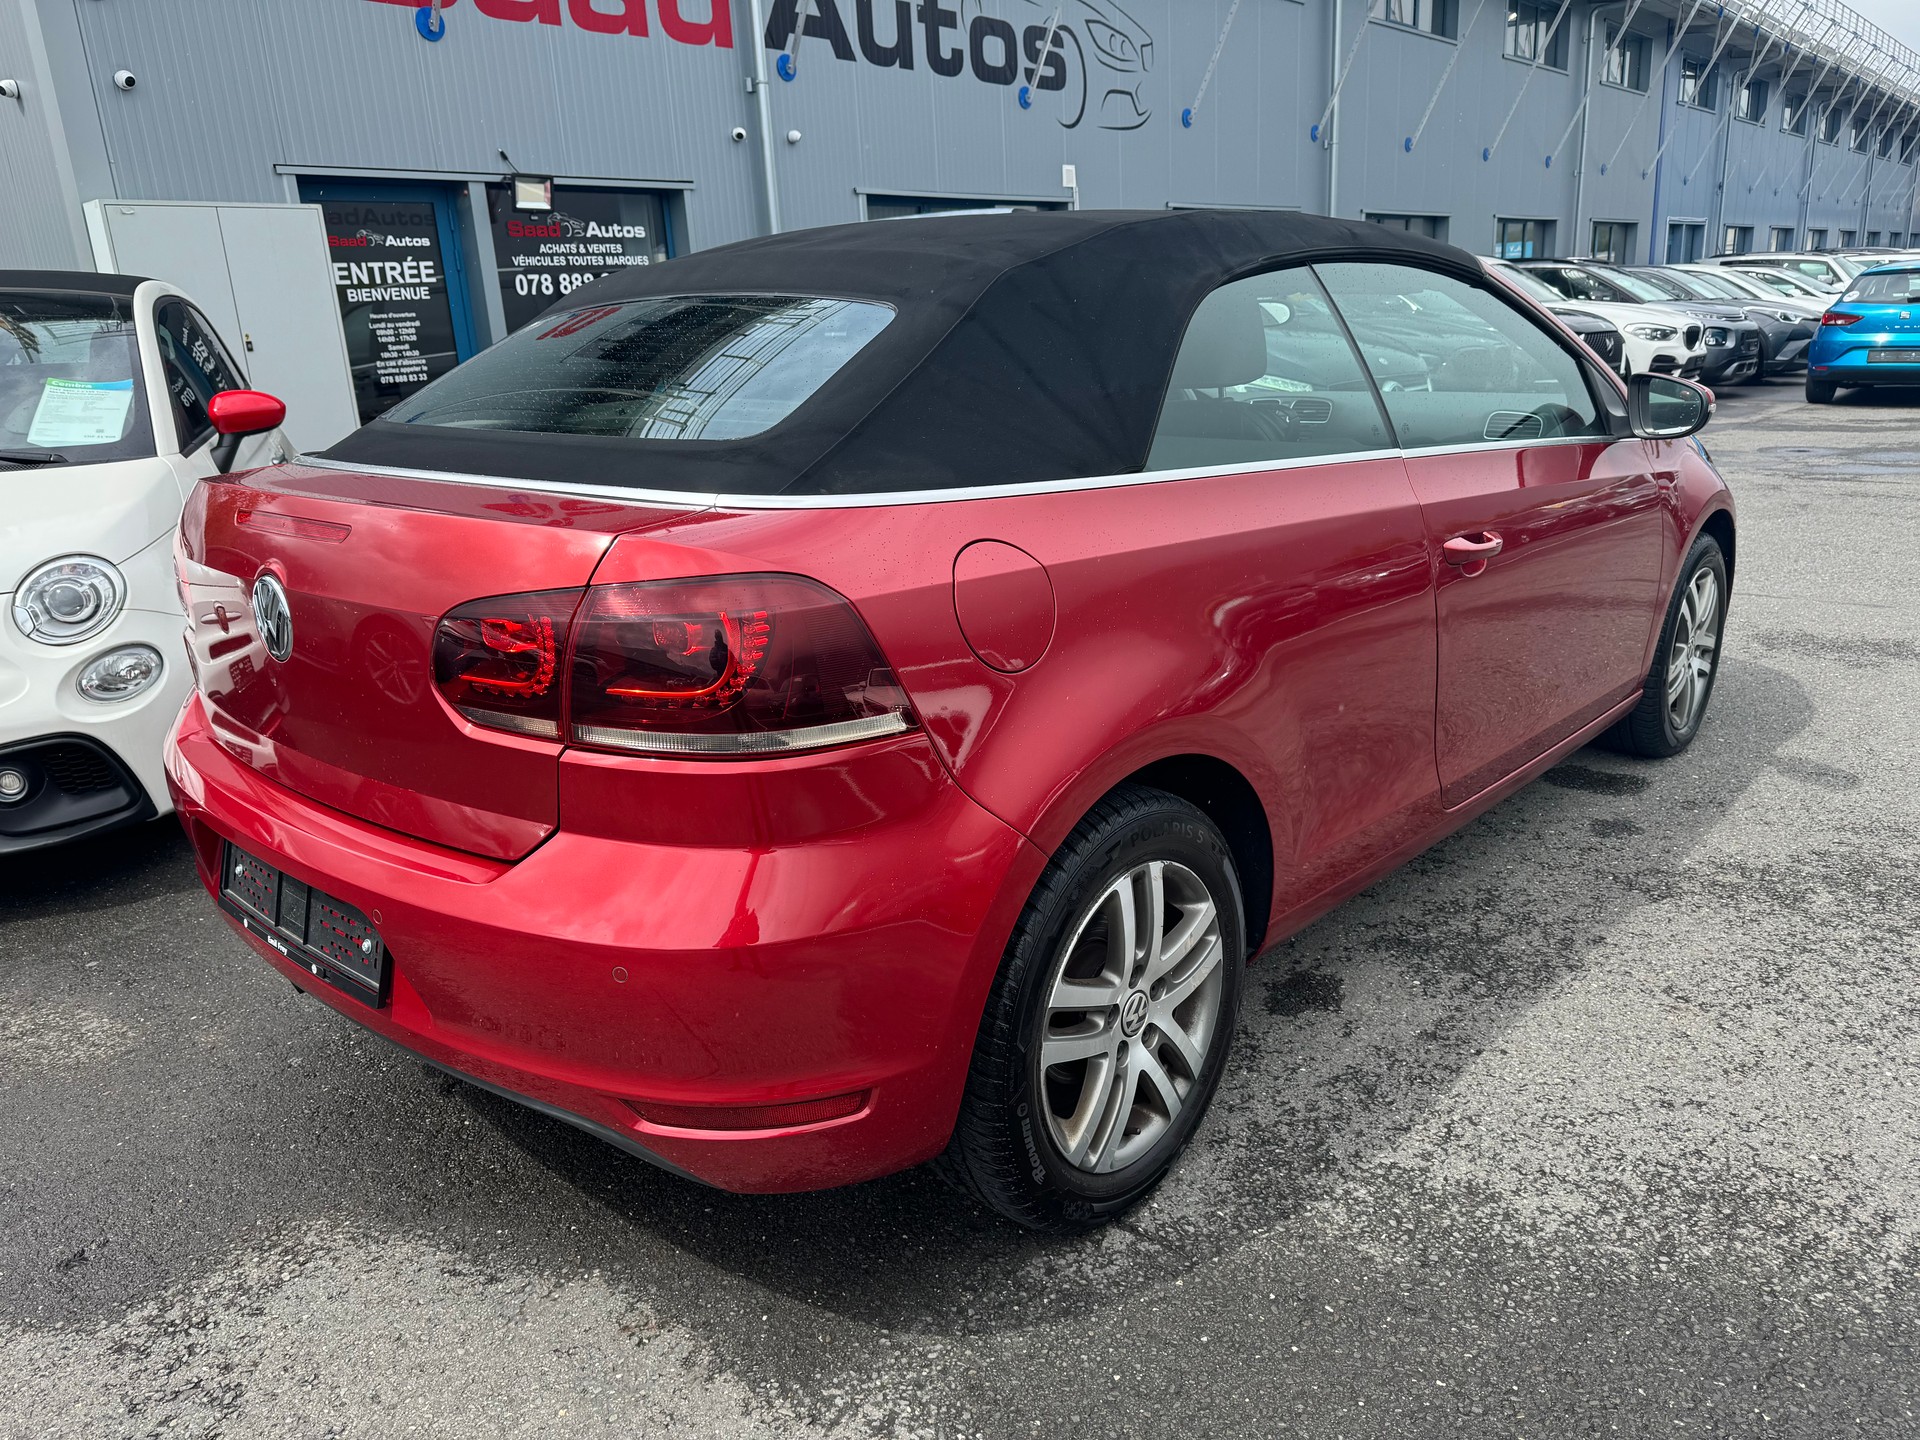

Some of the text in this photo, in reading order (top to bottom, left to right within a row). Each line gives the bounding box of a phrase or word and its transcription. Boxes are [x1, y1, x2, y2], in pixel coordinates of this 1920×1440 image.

[766, 0, 1067, 92] Autos
[507, 220, 646, 238] Saad Autos
[328, 235, 431, 247] Saad Autos
[540, 243, 622, 254] ACHATS & VENTES
[512, 254, 649, 266] VÉHICULES TOUTES MARQUES
[332, 256, 437, 285] ENTRÉE
[515, 273, 554, 296] 078
[346, 286, 431, 303] BIENVENUE
[369, 321, 386, 329] Lundi
[400, 366, 420, 374] appeler
[380, 373, 428, 384] 078 888 83 33
[1130, 821, 1194, 848] POLARIS
